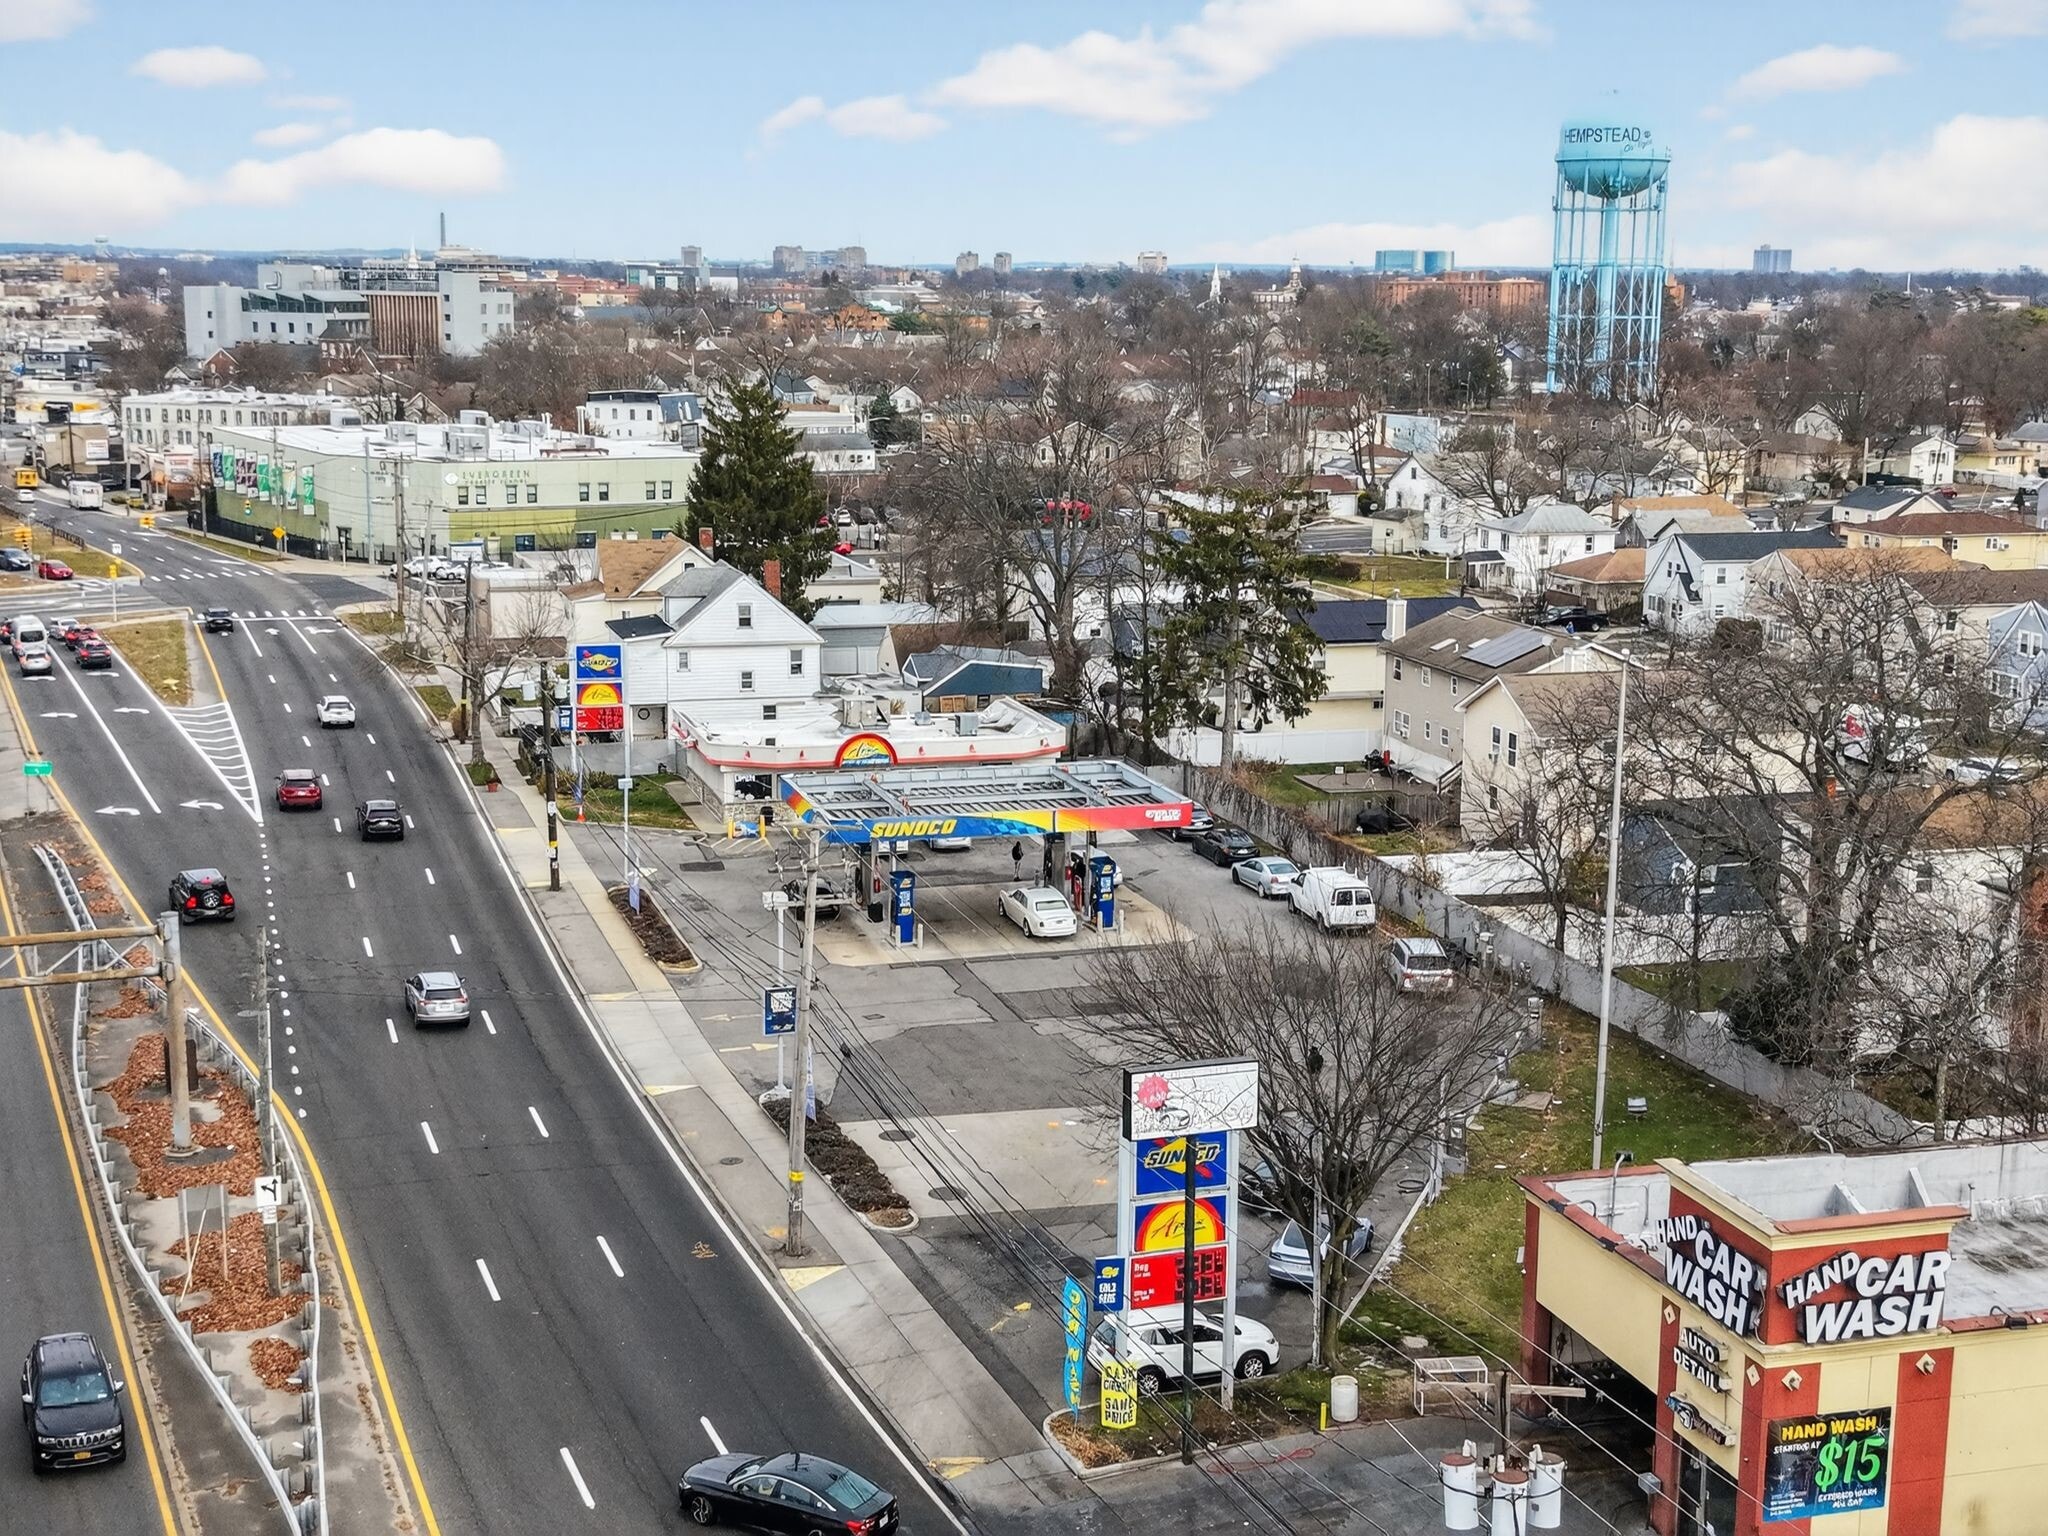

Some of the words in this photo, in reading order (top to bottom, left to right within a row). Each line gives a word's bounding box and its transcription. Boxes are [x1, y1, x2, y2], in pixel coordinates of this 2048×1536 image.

[1564, 127, 1641, 143] HEMPSTEAD
[869, 819, 958, 838] SUNOCO
[1145, 1144, 1219, 1167] SUNCO
[1657, 1215, 1698, 1243] HAND
[1695, 1230, 1752, 1298] CAR
[1785, 1252, 1860, 1309] HAND
[1856, 1251, 1951, 1297] CAR
[1666, 1245, 1748, 1336] WASH
[1805, 1291, 1945, 1344] WASH
[1673, 1346, 1719, 1393] DETAIL
[1681, 1328, 1716, 1364] AUTO
[1781, 1422, 1827, 1441] HAND
[1831, 1416, 1877, 1435] WASH
[1815, 1435, 1885, 1492] $15
